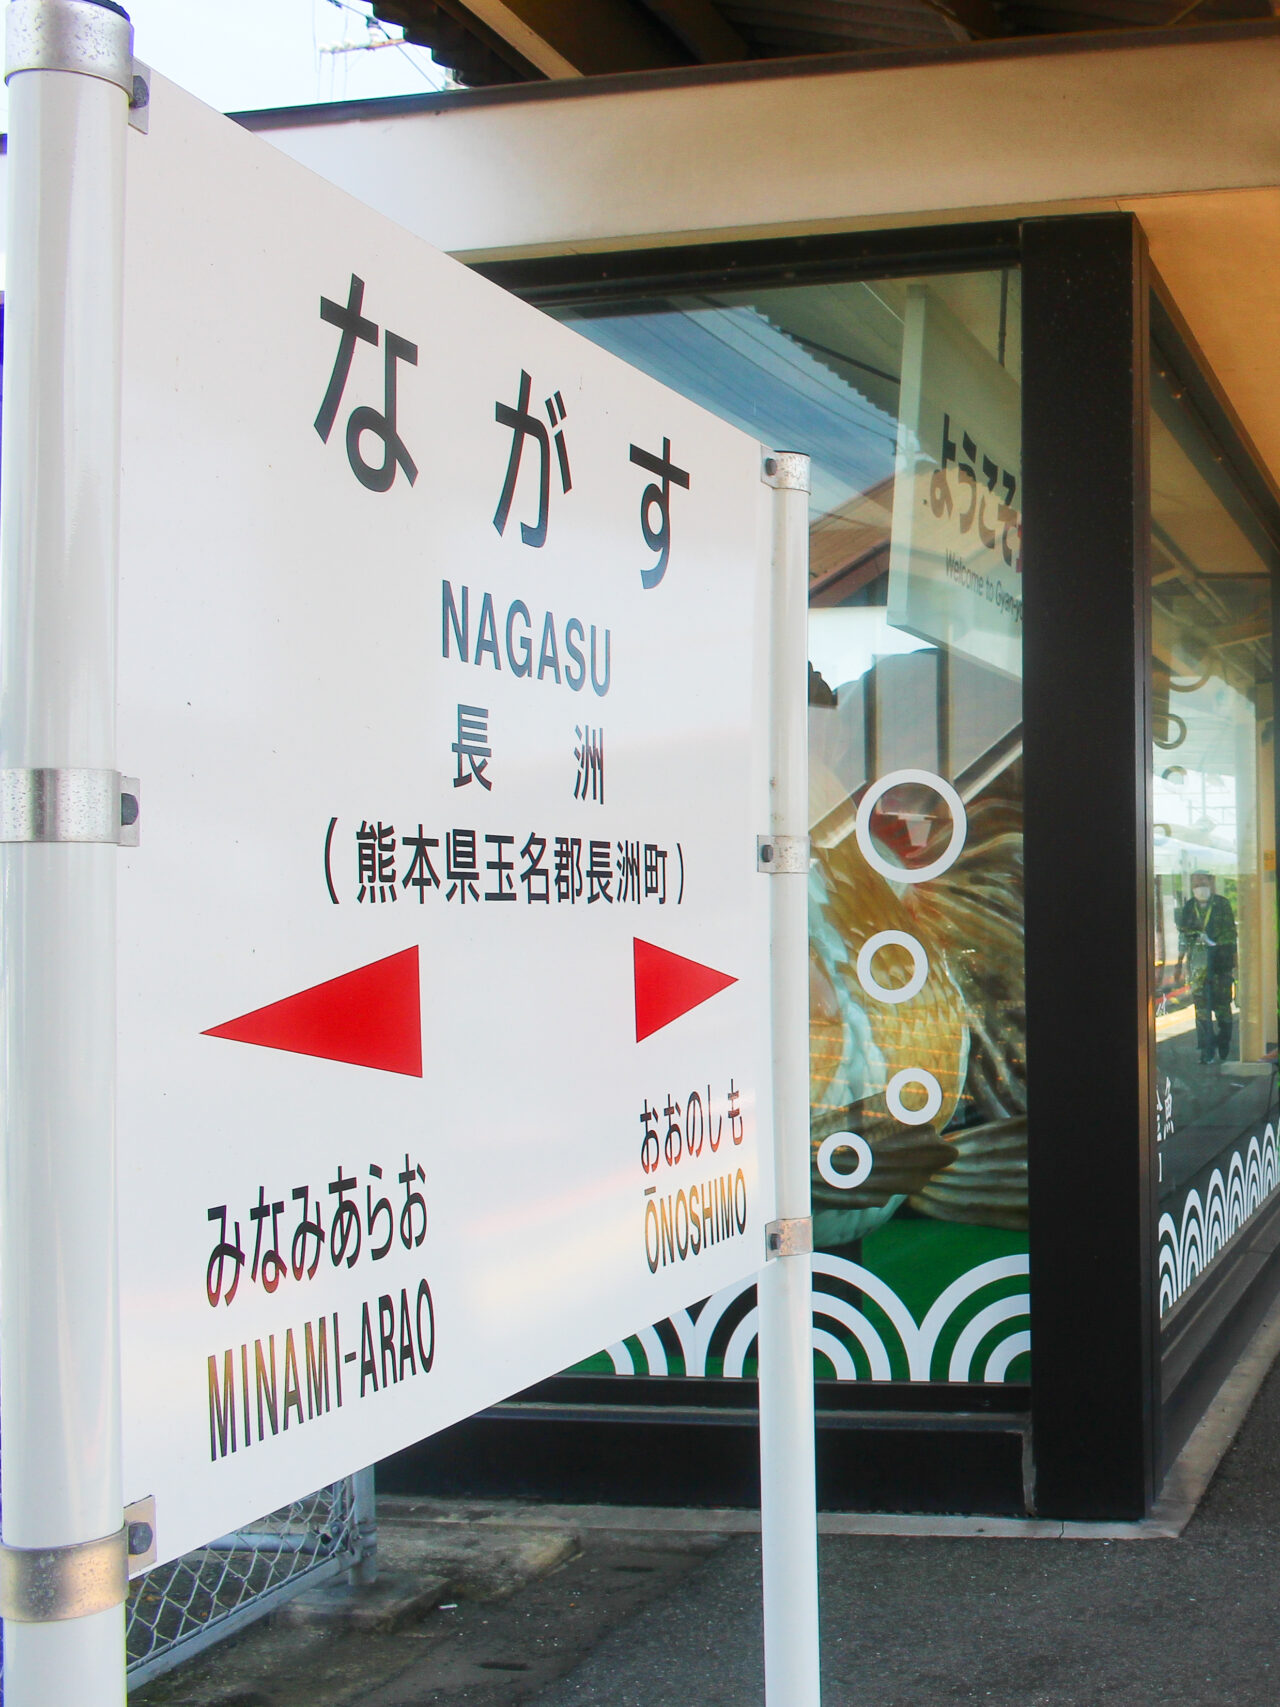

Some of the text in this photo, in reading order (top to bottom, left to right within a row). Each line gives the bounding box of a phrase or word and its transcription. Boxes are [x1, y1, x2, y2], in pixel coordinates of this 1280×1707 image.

[313, 273, 690, 589] ながす
[945, 547, 984, 597] Welcome
[985, 575, 994, 603] to
[442, 579, 611, 698] NAGASU
[451, 703, 605, 805] 長洲
[324, 817, 685, 905] (熊本県玉名郡長洲町)
[640, 1079, 745, 1175] おおのしも
[206, 1153, 428, 1308] みなみあらお
[207, 1278, 436, 1462] MINAMI-ARAO
